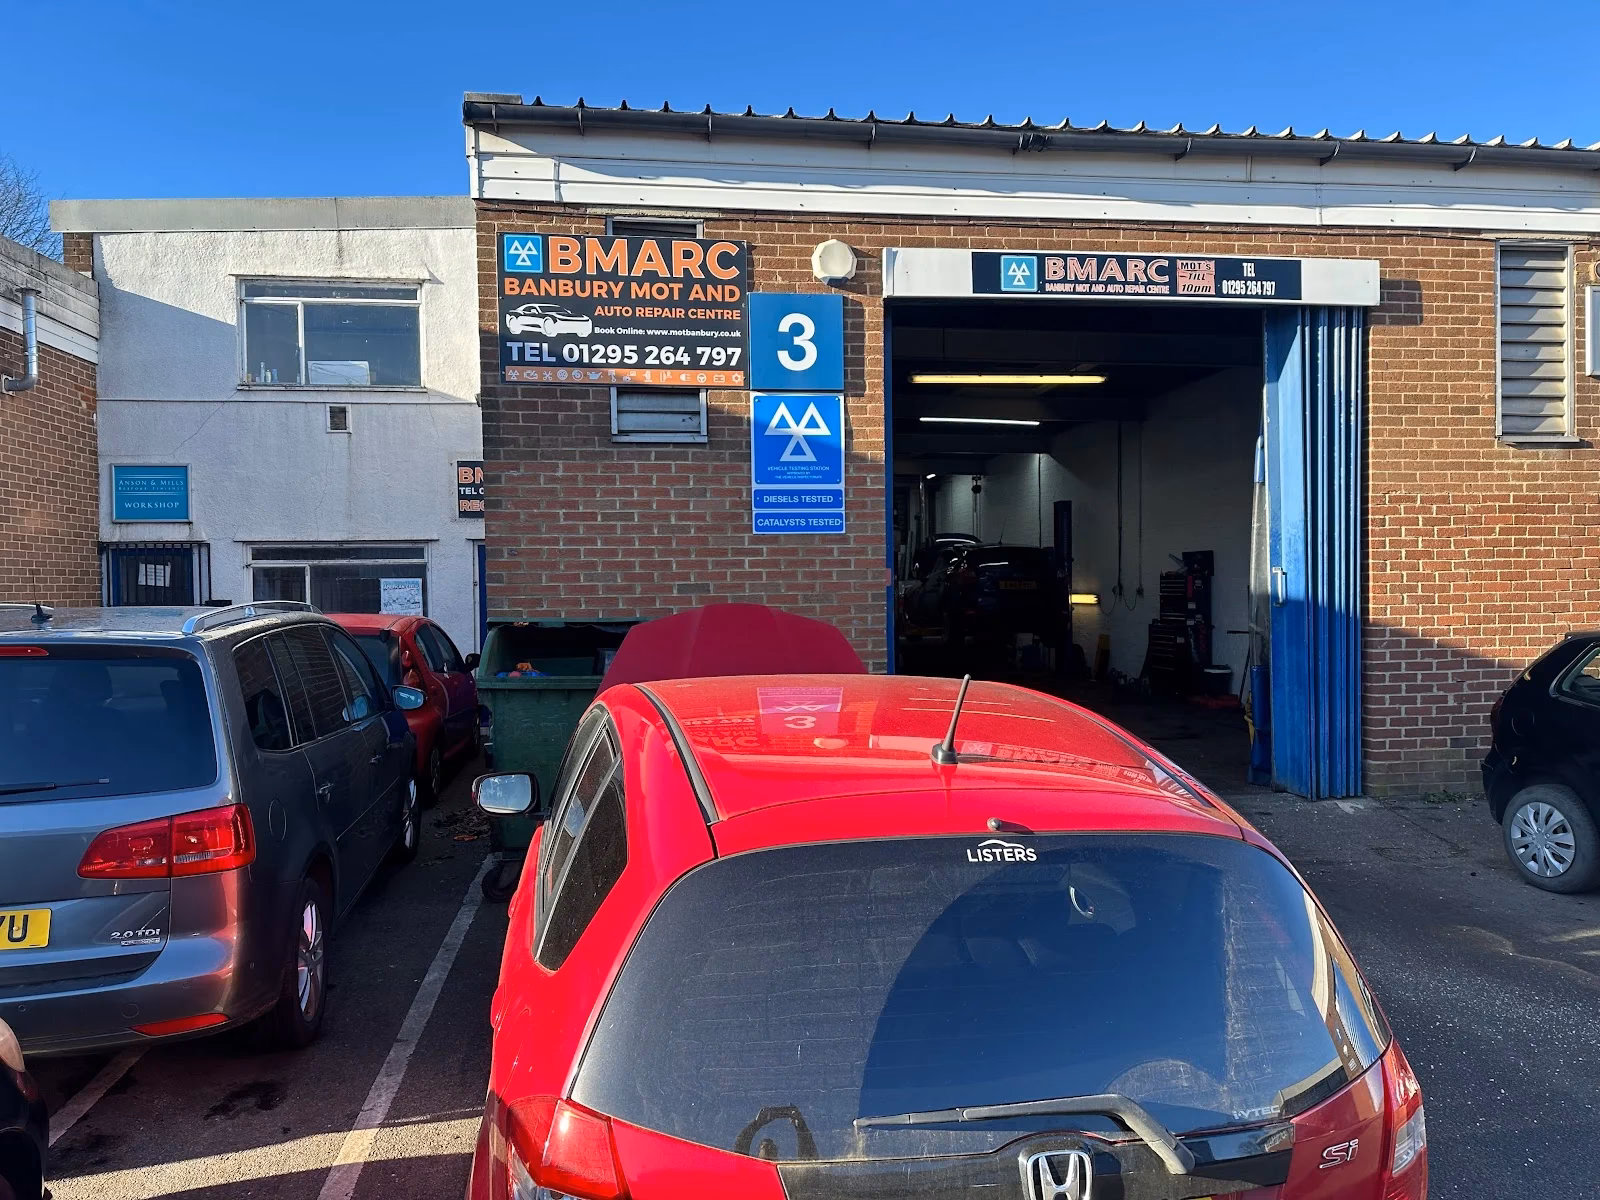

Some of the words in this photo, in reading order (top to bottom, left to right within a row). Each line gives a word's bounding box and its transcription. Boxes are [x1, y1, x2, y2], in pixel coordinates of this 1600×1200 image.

[548, 235, 741, 280] BMARC
[1044, 256, 1170, 283] BMARC
[1188, 272, 1207, 281] TILL
[1242, 262, 1256, 277] TEL
[504, 277, 625, 299] BANBURY
[630, 282, 684, 300] MOT
[688, 284, 741, 302] AND
[1045, 283, 1075, 292] BANBURY
[1075, 284, 1090, 293] MOT
[1091, 284, 1106, 293] AND
[1106, 284, 1124, 293] AUTO
[1125, 285, 1146, 294] REPAIR
[1146, 285, 1170, 295] CENTRE
[1182, 283, 1212, 293] 10pm
[1222, 280, 1247, 295] 01295
[1246, 281, 1262, 295] 264
[1262, 281, 1276, 296] 797
[594, 305, 633, 317] AUTO
[635, 306, 686, 319] REPAIR
[688, 308, 741, 320] CENTRE
[594, 326, 615, 335] Book
[616, 327, 646, 336] Online:
[646, 328, 741, 338] www.motbanbury.co.uk
[776, 312, 818, 372] 3
[506, 341, 557, 362] TEL
[562, 343, 639, 365] 01295
[644, 345, 691, 365] 264
[696, 346, 742, 367] 797
[459, 487, 478, 495] TEL
[124, 501, 180, 509] WORKSHOP
[763, 495, 800, 503] DIESELS
[800, 495, 834, 503] TESTED
[756, 518, 807, 527] CATALYSTS
[807, 518, 841, 527] TESTED
[966, 847, 1038, 862] LISTERS
[110, 930, 134, 940] 2.0
[135, 928, 161, 937] TDI
[1318, 1138, 1359, 1169] Si
